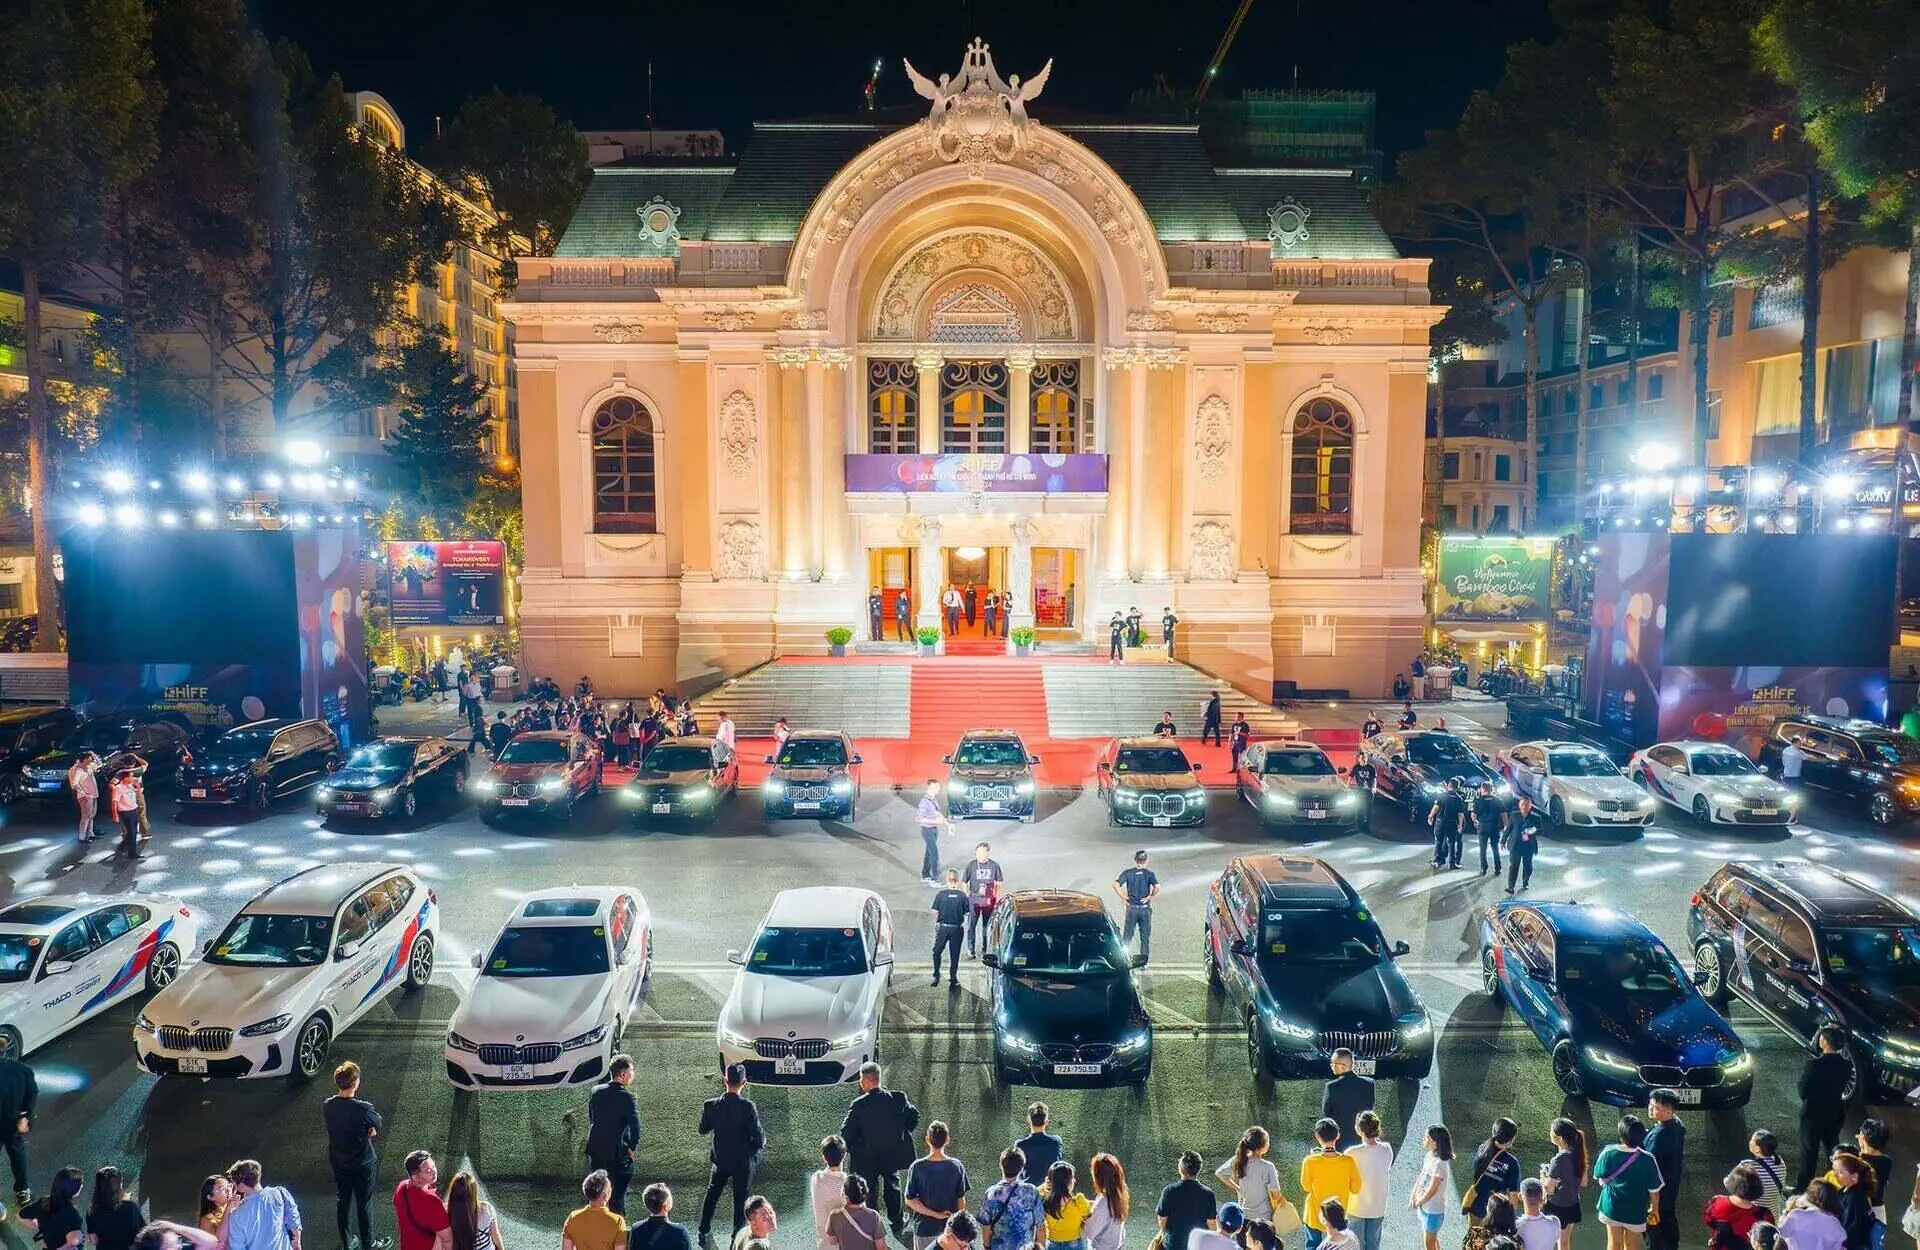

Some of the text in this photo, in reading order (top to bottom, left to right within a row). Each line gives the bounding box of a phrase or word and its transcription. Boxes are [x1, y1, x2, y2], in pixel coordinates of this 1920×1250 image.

[1455, 575, 1507, 593] Bamboo
[1765, 972, 1786, 992] THACO
[43, 991, 72, 1010] THACO
